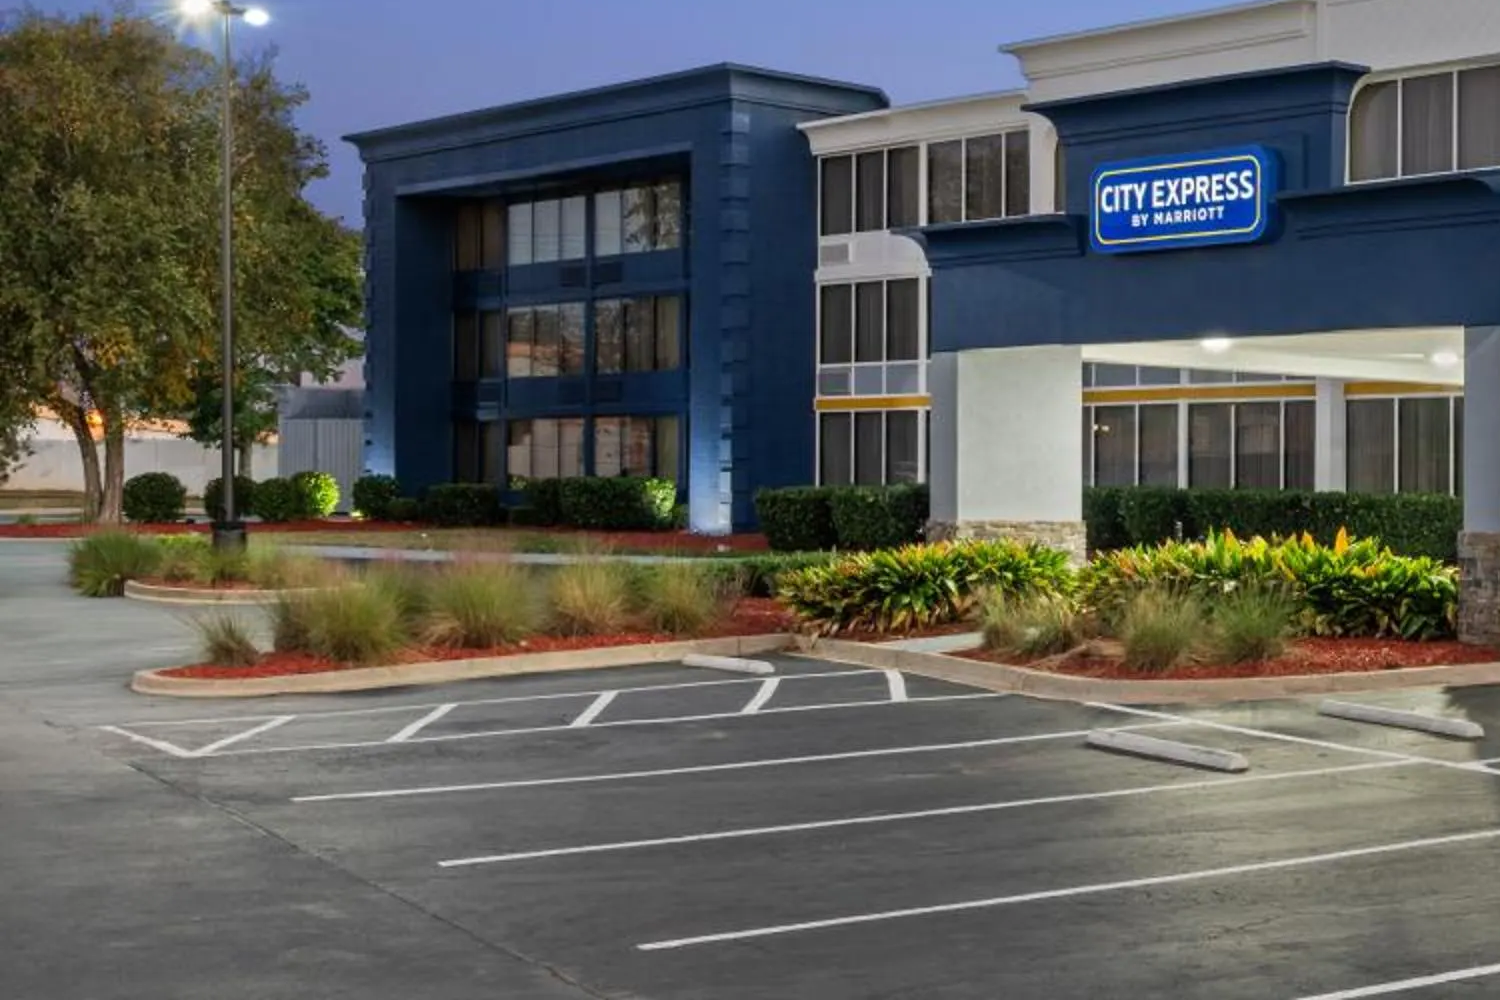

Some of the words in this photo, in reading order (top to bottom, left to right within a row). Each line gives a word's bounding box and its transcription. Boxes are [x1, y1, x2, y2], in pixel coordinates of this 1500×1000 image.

[1101, 182, 1147, 213] CITY
[1152, 170, 1254, 208] EXPRESS
[1131, 213, 1149, 227] BY
[1153, 206, 1225, 225] MARRIOTT
